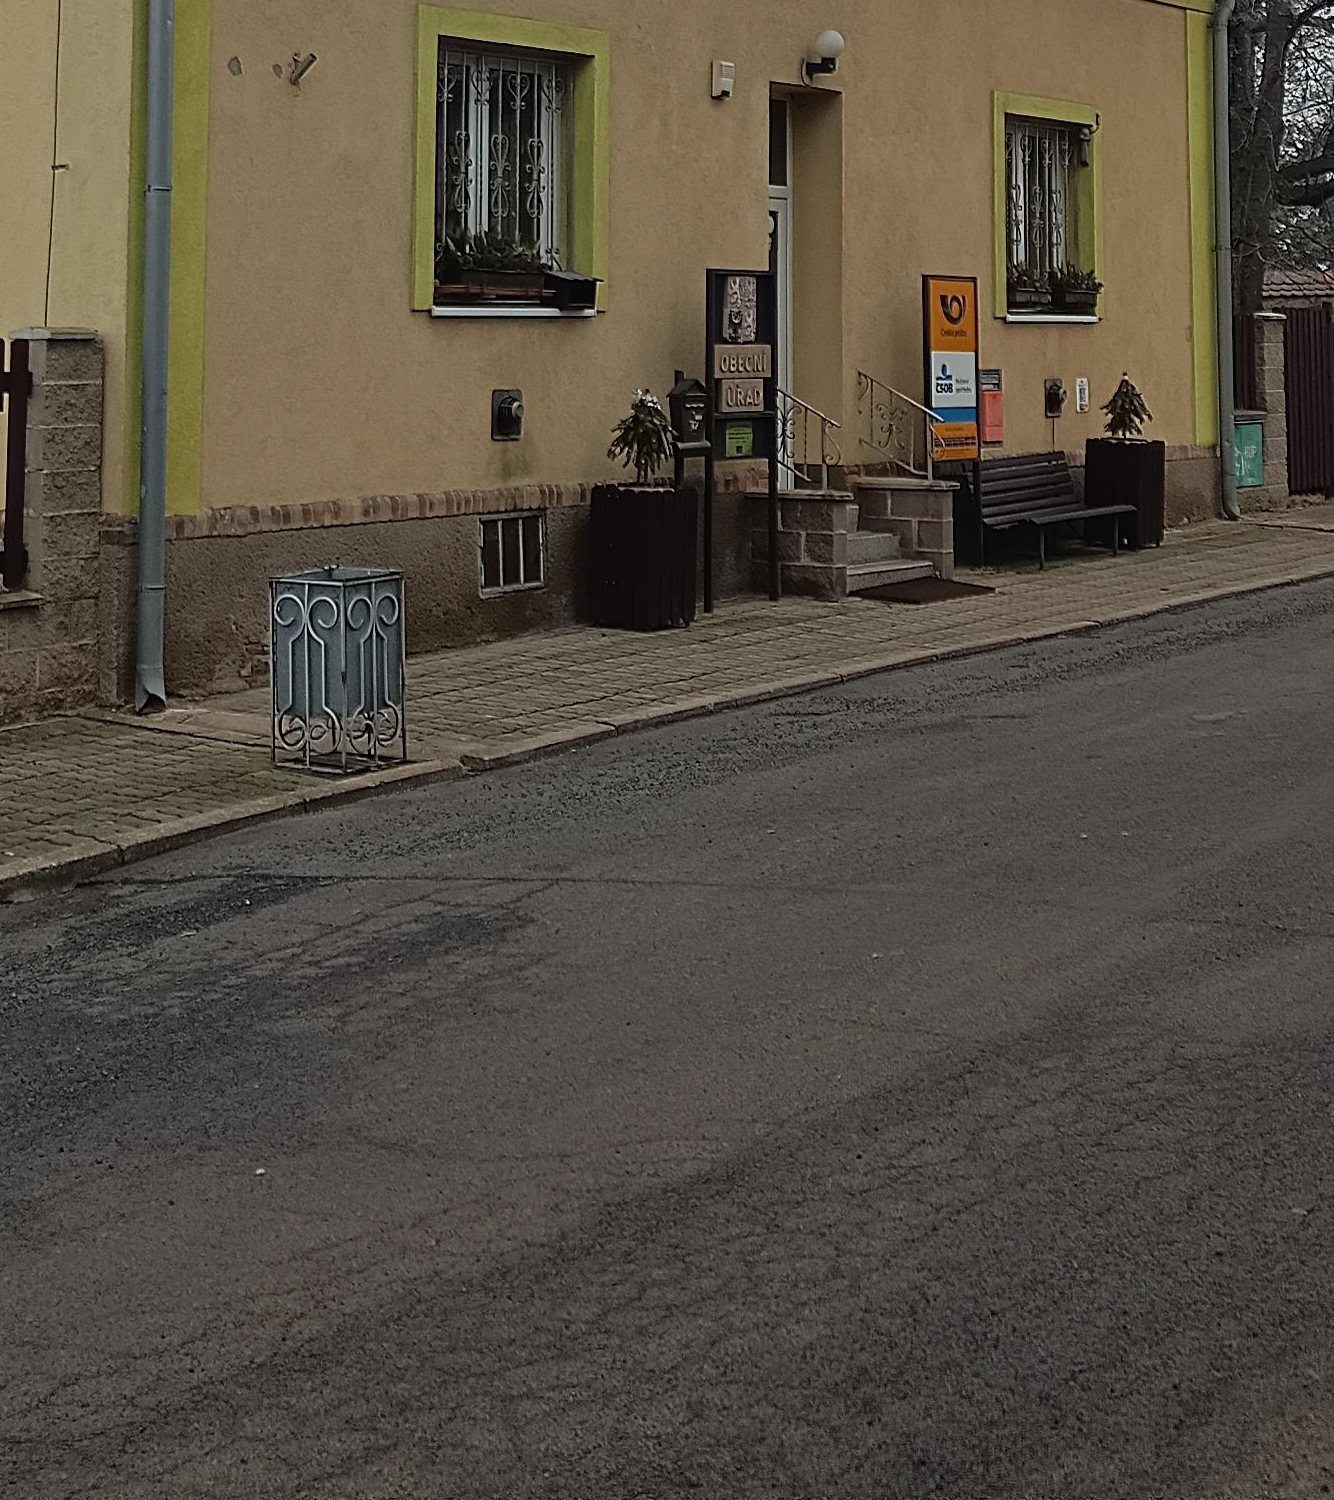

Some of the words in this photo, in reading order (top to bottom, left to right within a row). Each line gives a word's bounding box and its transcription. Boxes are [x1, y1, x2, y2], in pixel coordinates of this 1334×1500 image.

[720, 351, 767, 373] OBECNÍ
[727, 384, 762, 408] ÚŘAD
[935, 382, 954, 394] ČSOB
